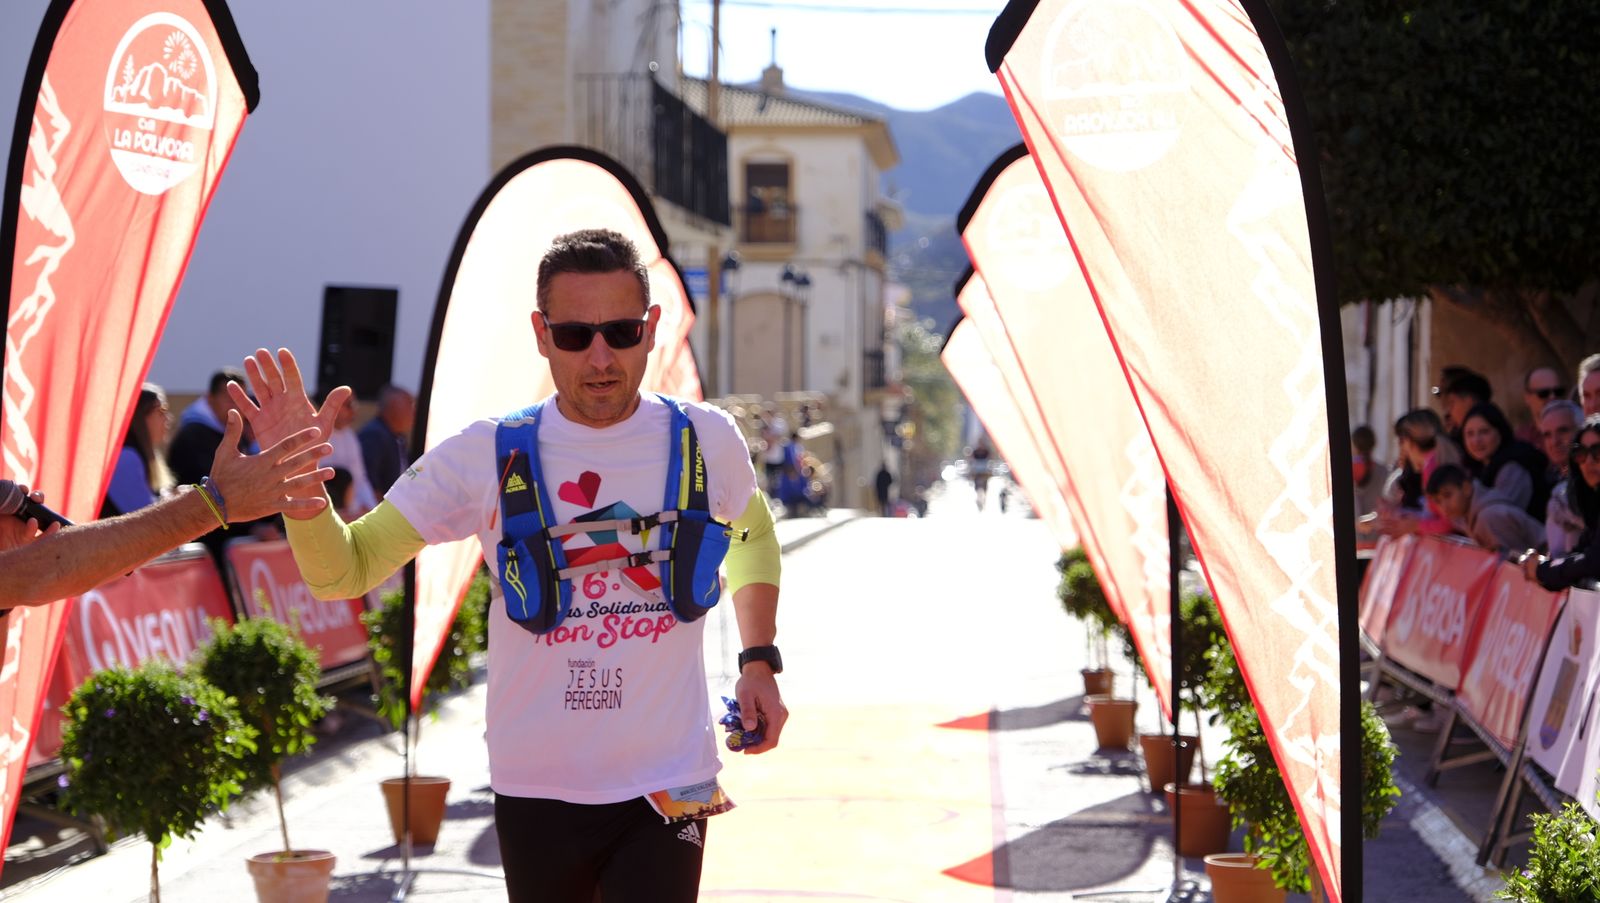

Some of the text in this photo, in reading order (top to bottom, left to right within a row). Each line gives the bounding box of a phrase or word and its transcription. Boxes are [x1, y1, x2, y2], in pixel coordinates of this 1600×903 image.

[114, 128, 194, 161] LA POLVORA
[597, 613, 678, 649] Stop
[567, 667, 623, 688] JESUS
[565, 689, 622, 710] PEREGRIN
